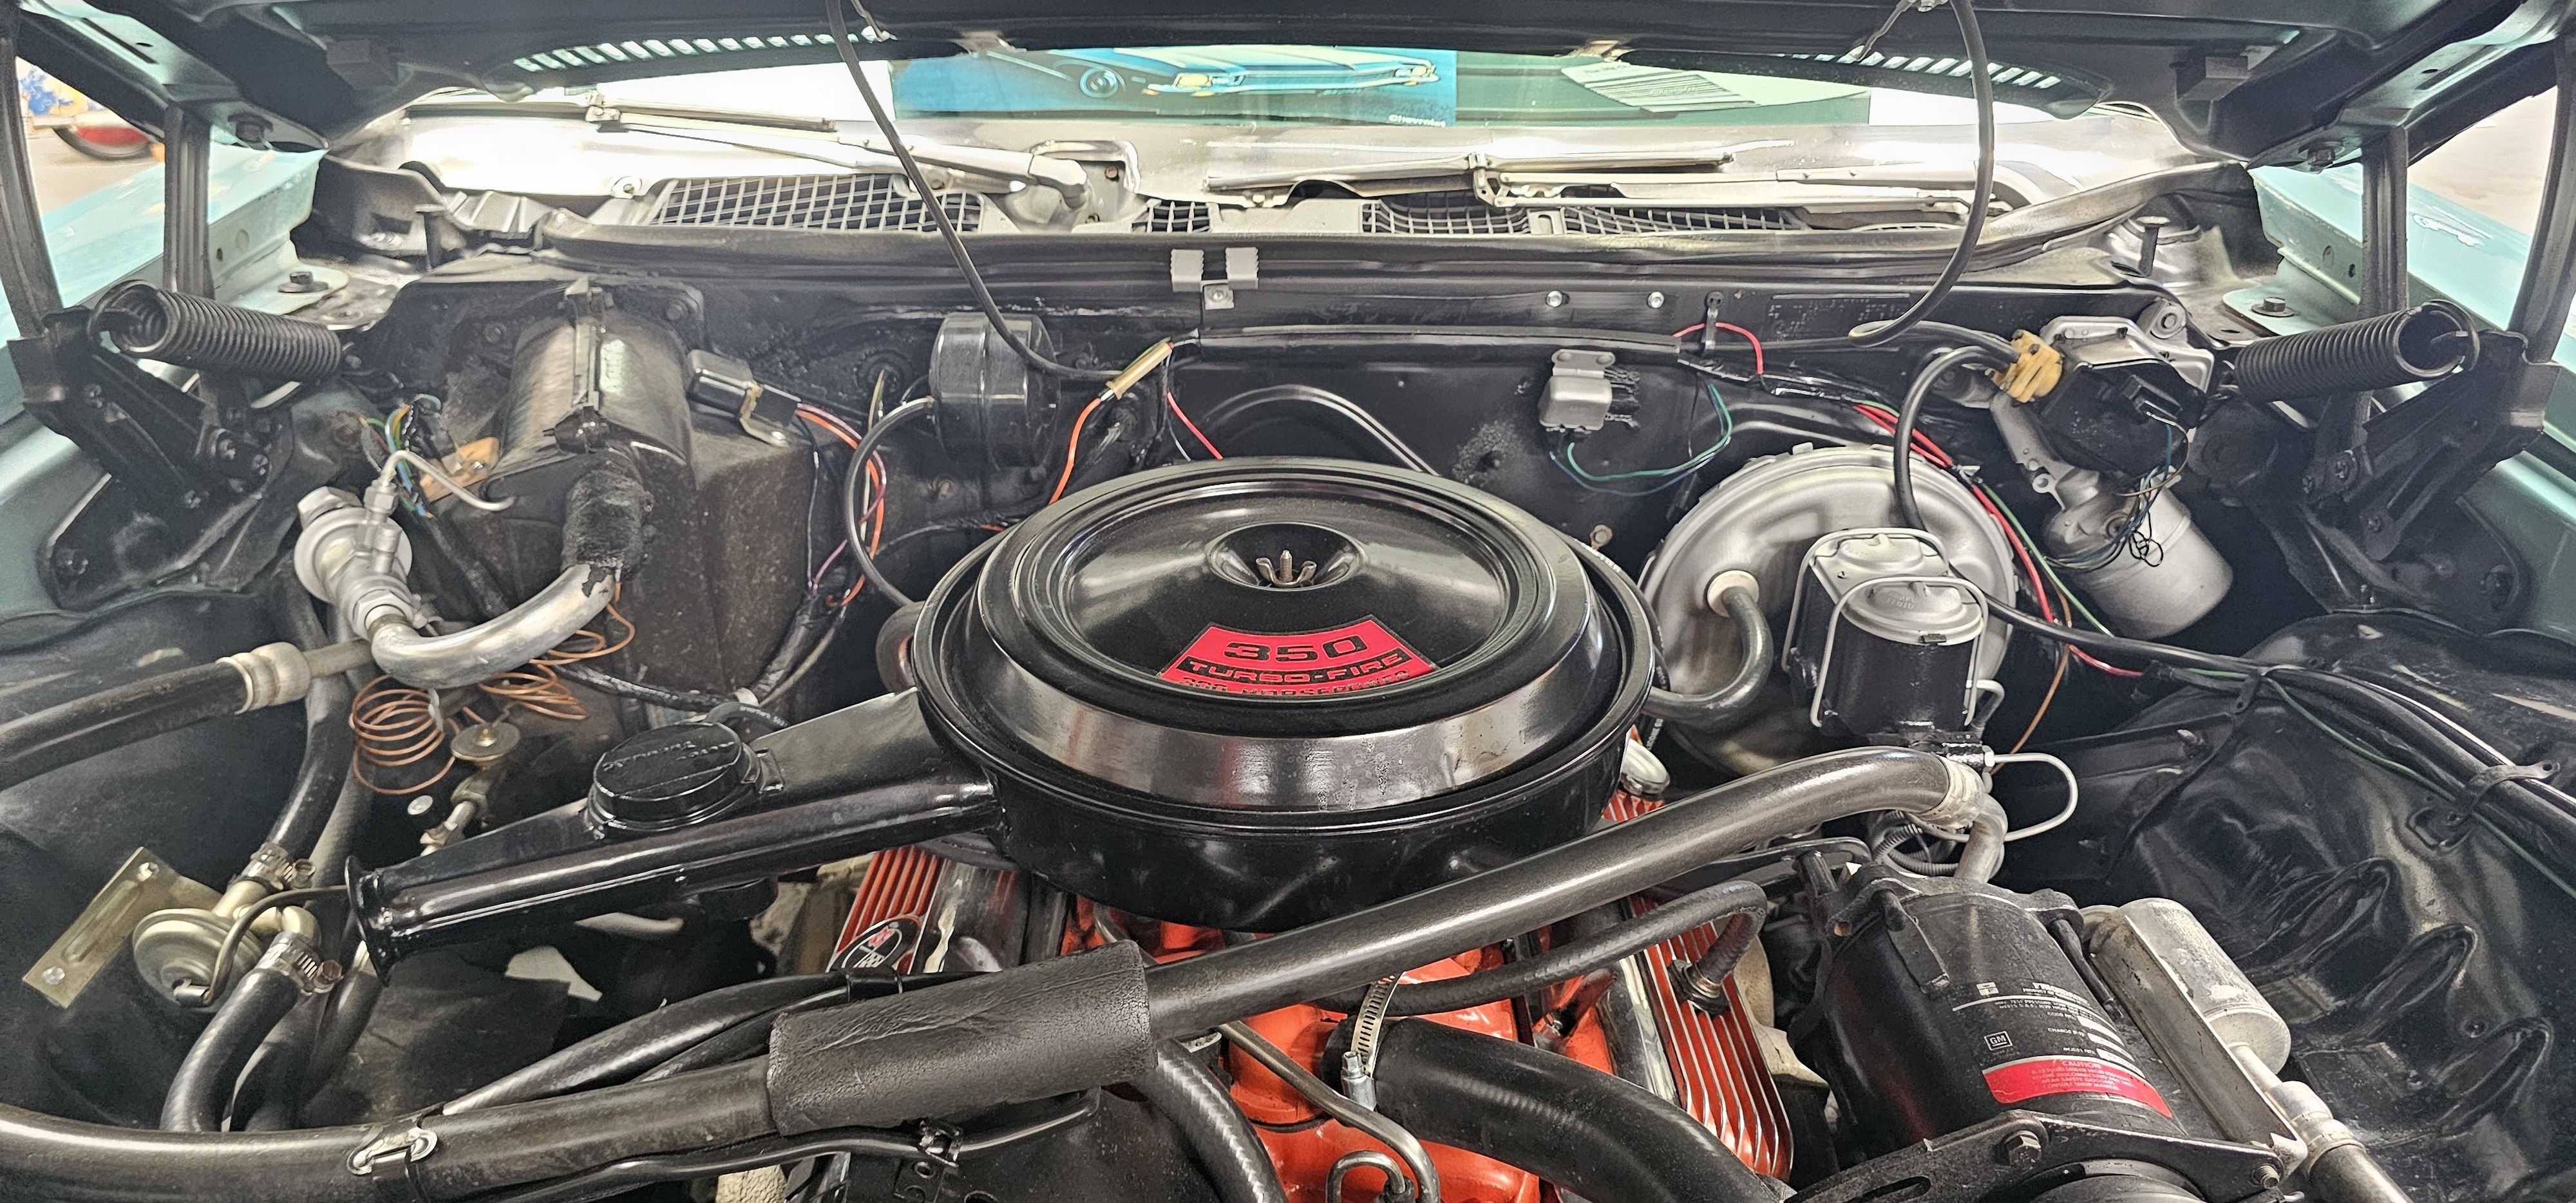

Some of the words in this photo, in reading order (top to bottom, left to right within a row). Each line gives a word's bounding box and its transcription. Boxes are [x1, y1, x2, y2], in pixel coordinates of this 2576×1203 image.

[1223, 635, 1368, 662] 350
[1189, 653, 1404, 683] TURBO-FIRE
[1989, 1035, 2007, 1044] GM
[2061, 1060, 2101, 1069] CAUTION
